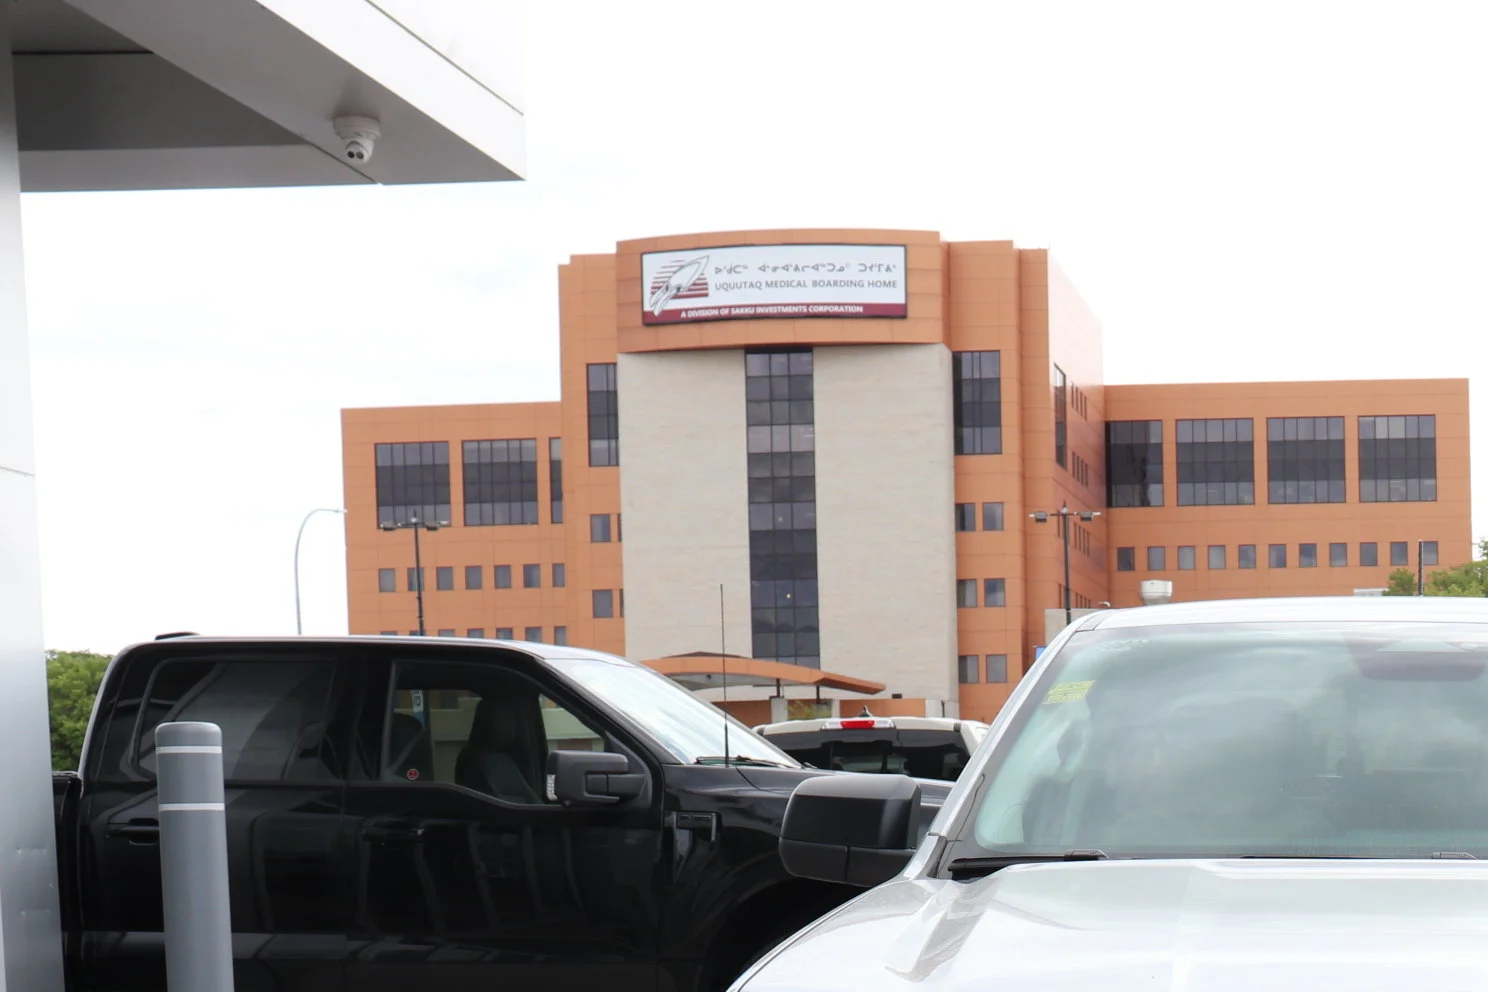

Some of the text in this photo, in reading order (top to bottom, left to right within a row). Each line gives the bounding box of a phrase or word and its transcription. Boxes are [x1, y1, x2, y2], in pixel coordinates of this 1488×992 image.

[714, 279, 898, 291] UQUUTAQ MEDICAL BOARDING HOME
[687, 309, 719, 317] DIVISION
[756, 306, 808, 314] INVESTMENTS
[808, 305, 864, 313] CORPORATION
